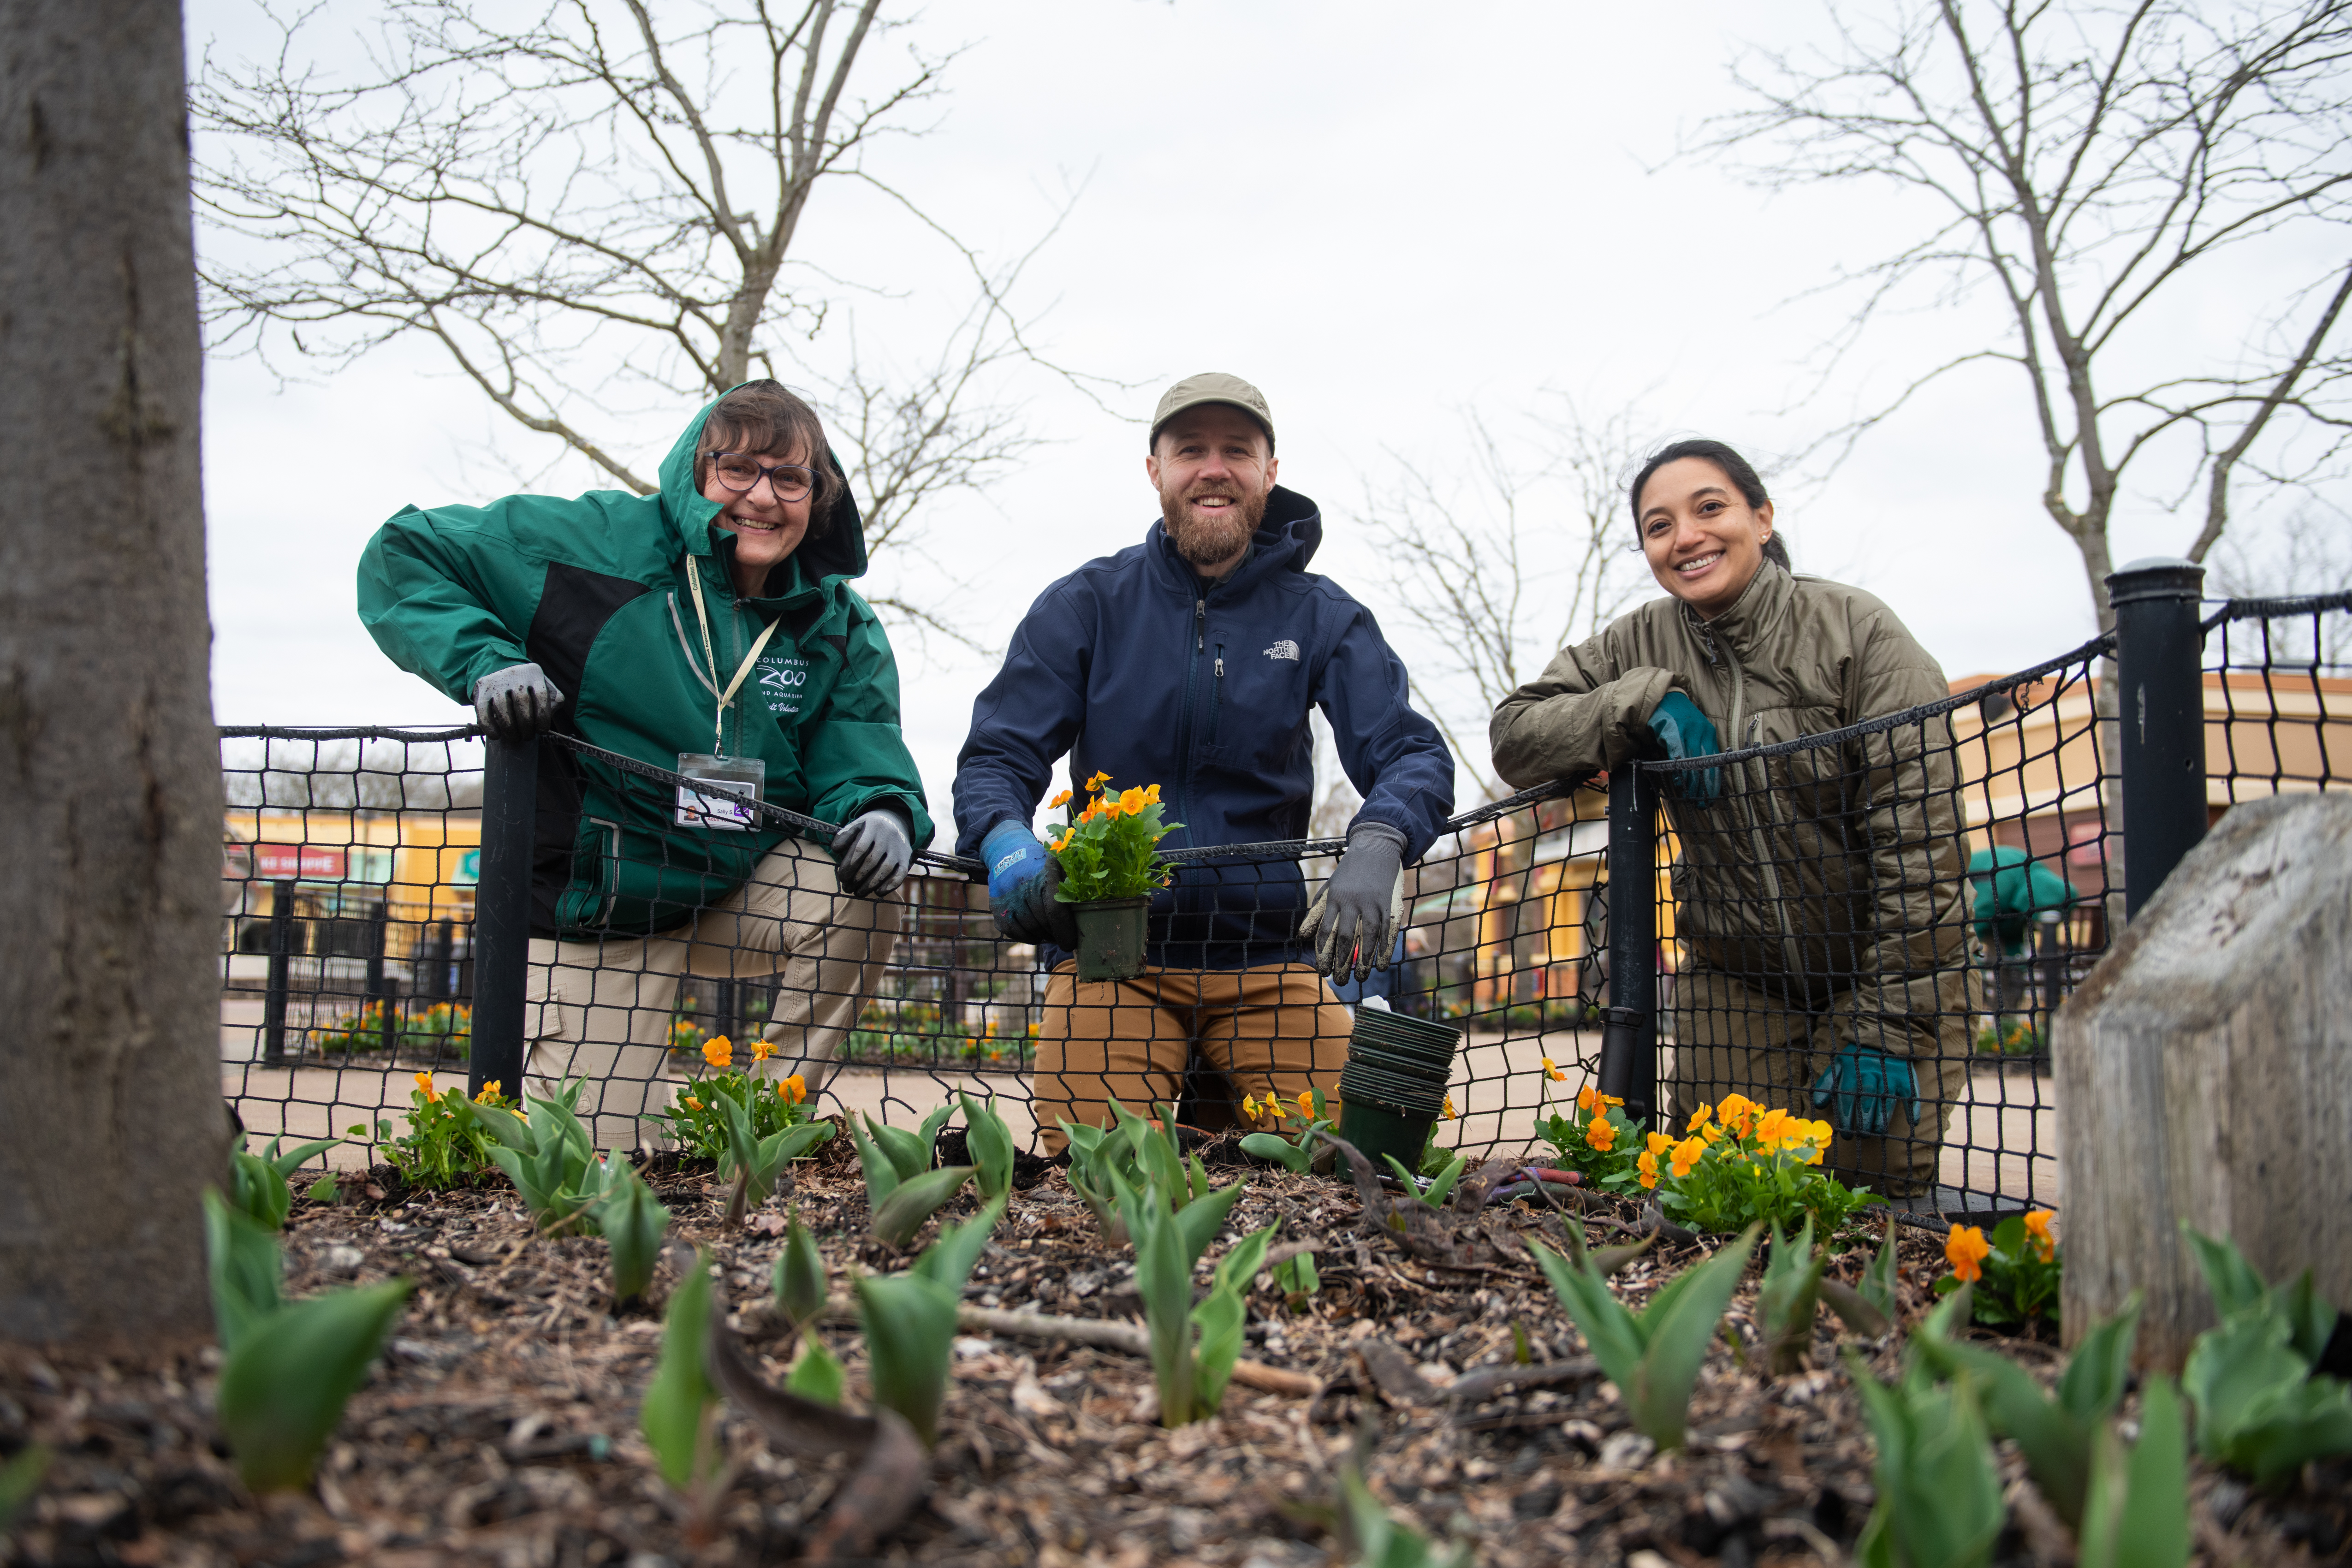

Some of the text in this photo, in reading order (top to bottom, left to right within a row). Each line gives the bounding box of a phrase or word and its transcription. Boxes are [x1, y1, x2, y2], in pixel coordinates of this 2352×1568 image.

[689, 566, 698, 591] Columbus
[756, 657, 809, 666] COLUMBUS
[1263, 646, 1289, 655] NORTH
[756, 665, 807, 690] ZOO
[994, 850, 1023, 873] FROST
[996, 855, 1023, 876] BUSTERS
